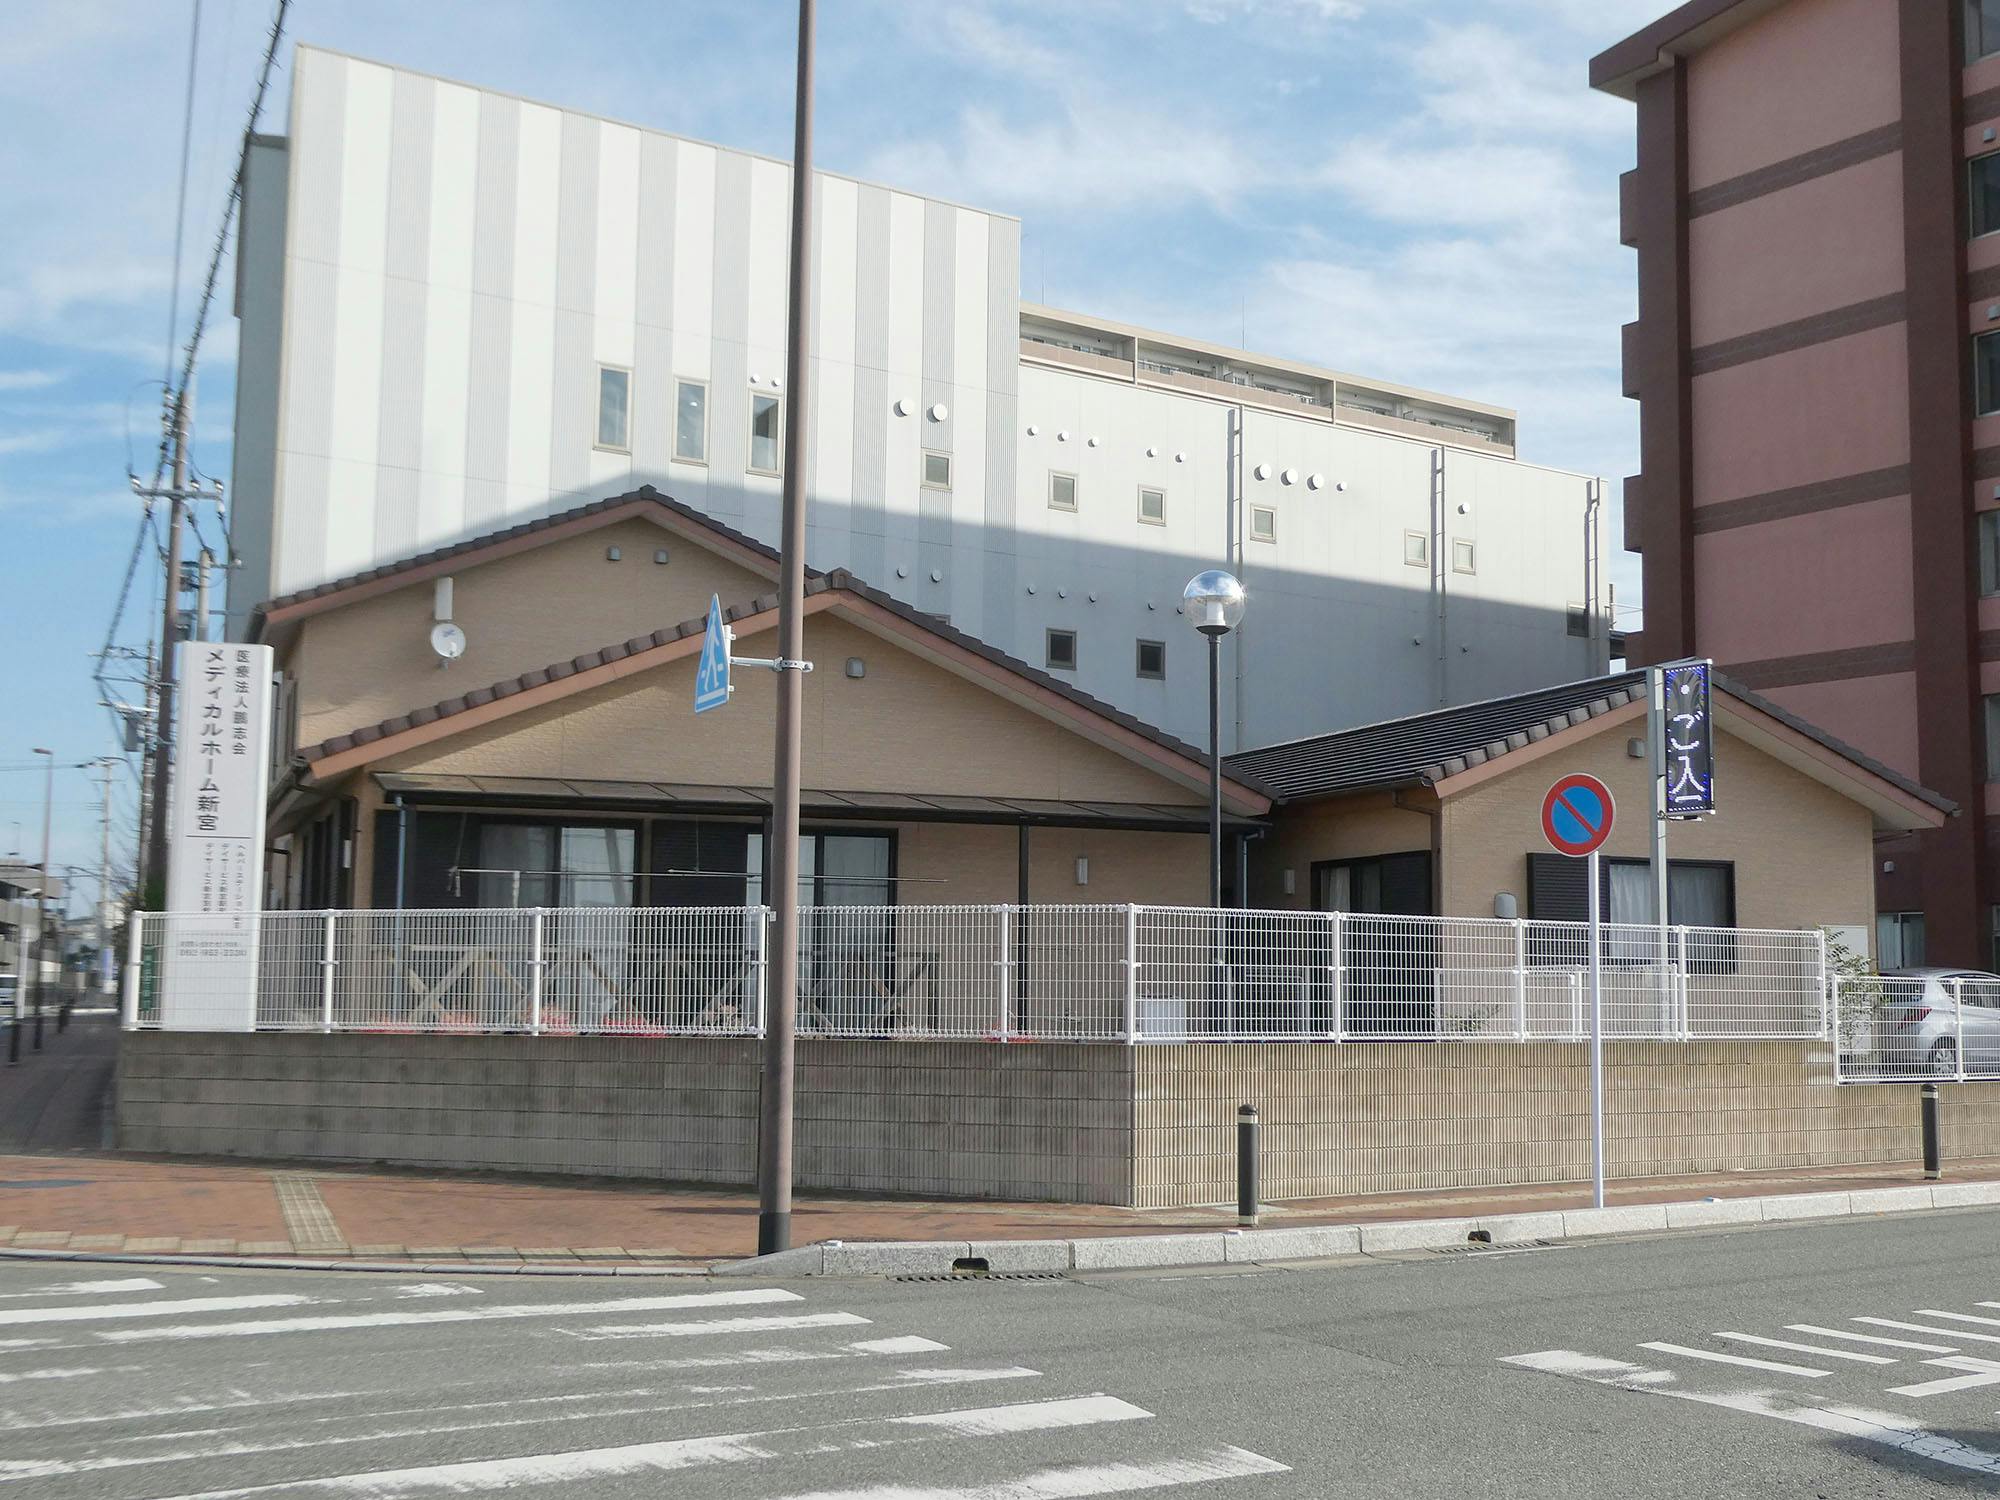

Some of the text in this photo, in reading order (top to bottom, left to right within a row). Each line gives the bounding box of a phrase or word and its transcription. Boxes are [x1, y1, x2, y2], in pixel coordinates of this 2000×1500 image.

[197, 649, 227, 831] メディカルホーム新宮
